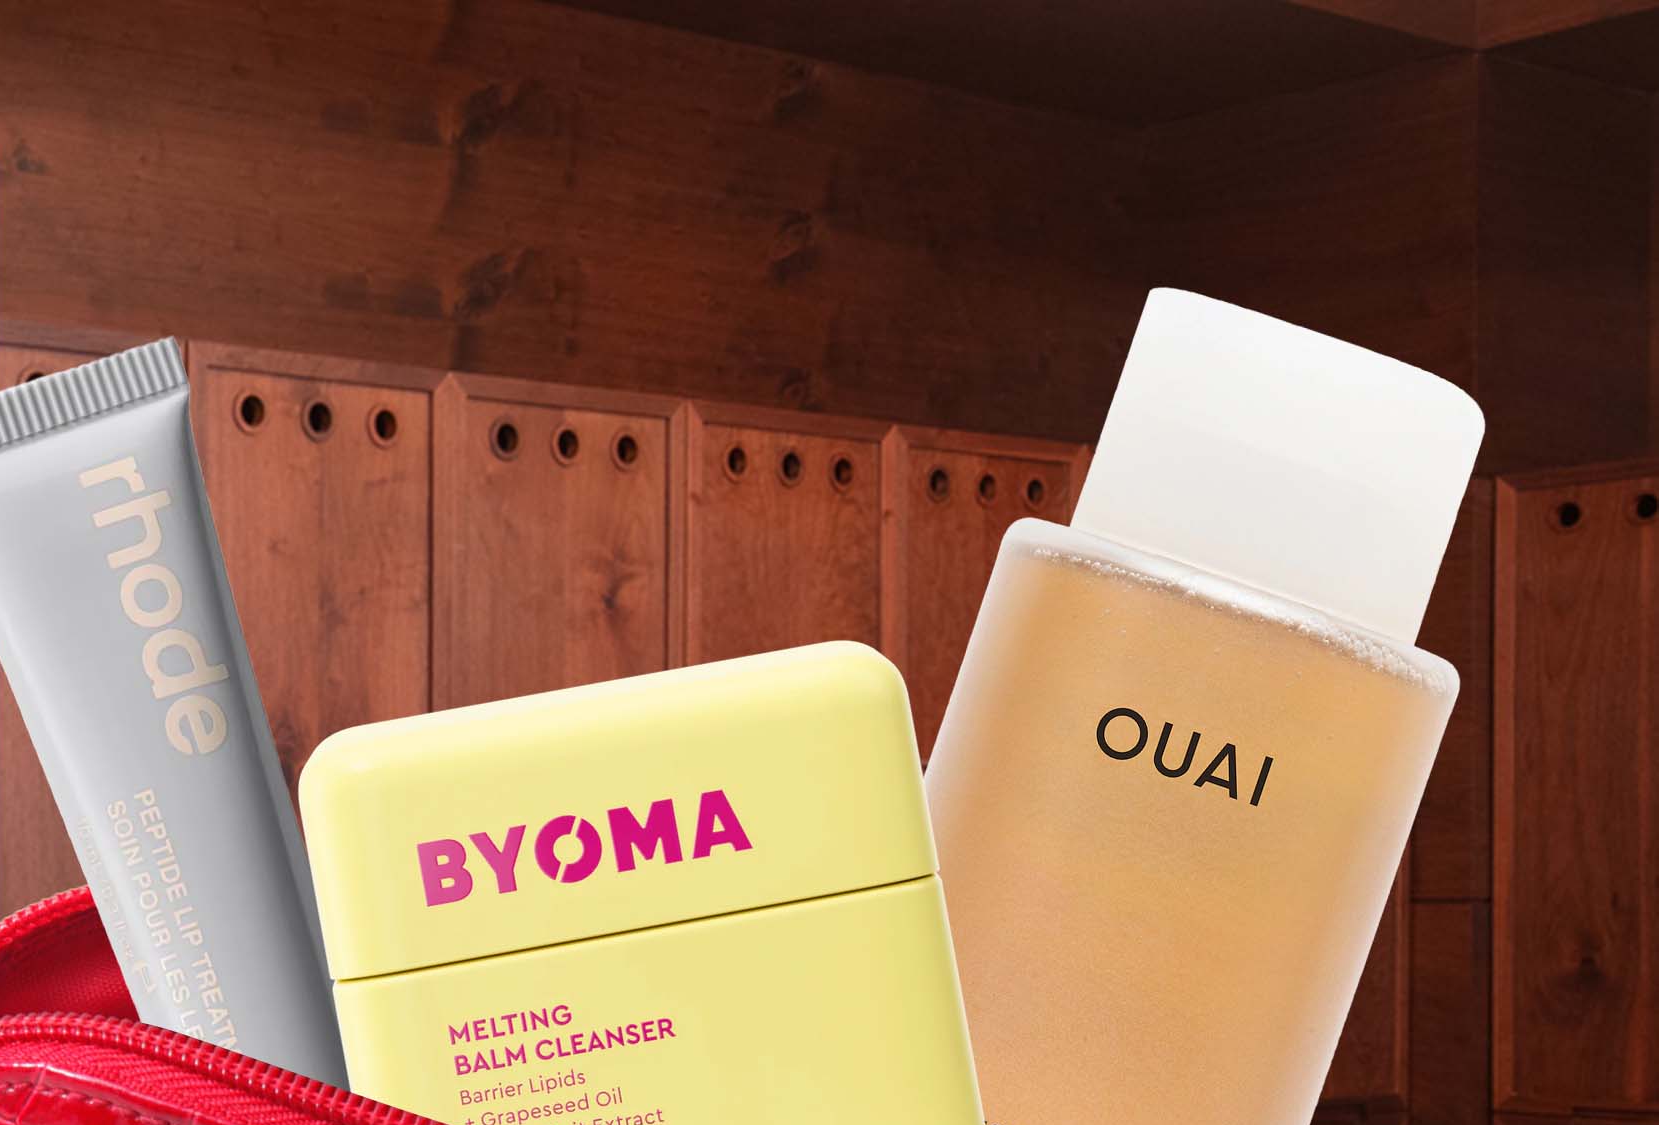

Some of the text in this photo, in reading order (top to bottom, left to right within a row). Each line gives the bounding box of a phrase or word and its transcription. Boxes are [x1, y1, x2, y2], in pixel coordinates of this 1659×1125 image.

[78, 456, 230, 755] rhode
[1096, 707, 1275, 807] OUAI
[134, 787, 188, 902] PEPTIDE
[173, 906, 203, 947] LIP
[417, 789, 753, 907] BYOMA
[107, 799, 143, 868] SOIN
[132, 871, 172, 948] POUR
[160, 953, 191, 1004] LES
[448, 1004, 573, 1045] MELTING
[453, 1017, 677, 1076] BALM CLEANSER
[459, 1068, 587, 1106] Barrier Lipids
[595, 1086, 624, 1108] Oil
